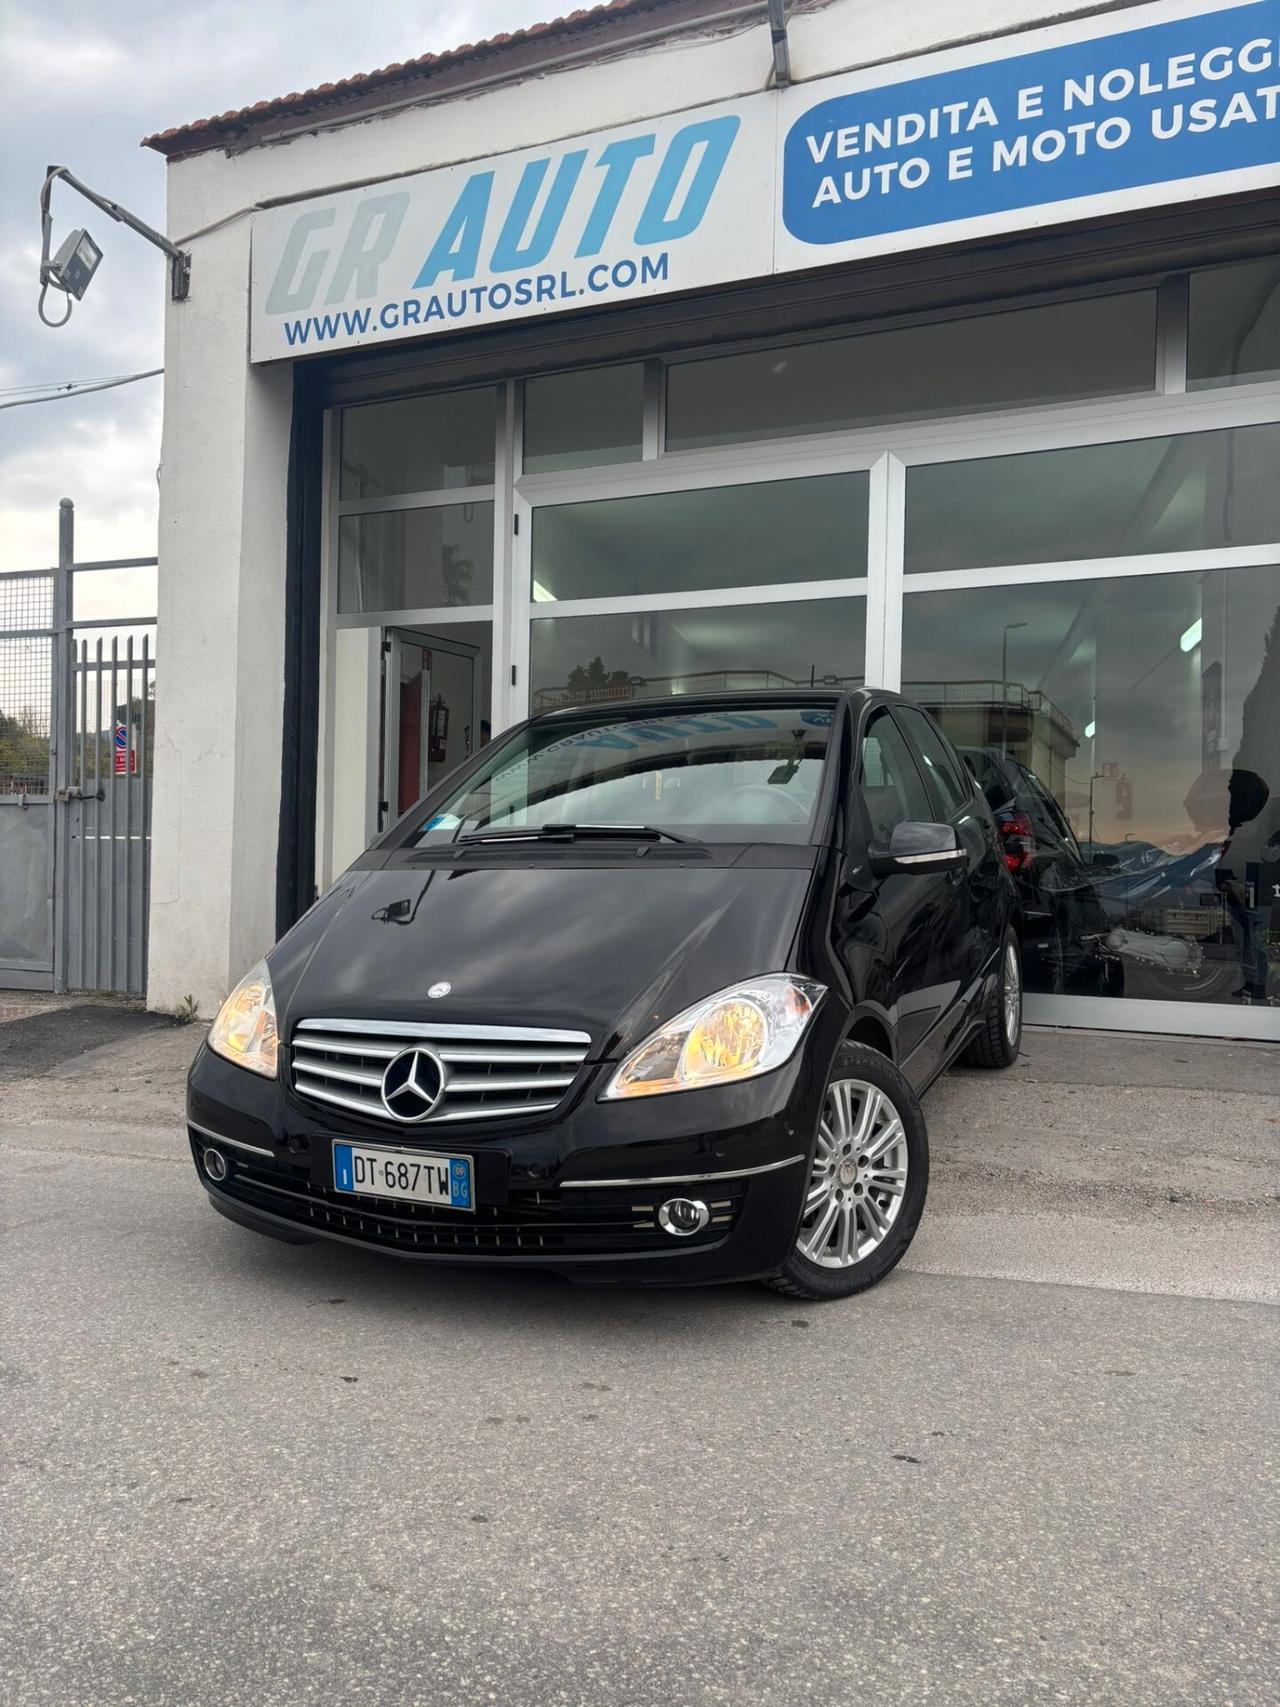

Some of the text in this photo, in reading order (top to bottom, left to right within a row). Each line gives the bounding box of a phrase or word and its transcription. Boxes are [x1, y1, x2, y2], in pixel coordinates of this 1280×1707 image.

[806, 35, 1280, 165] VENDITA E NOLEGG
[812, 84, 1280, 209] AUTO E MOTO USAT
[265, 114, 741, 316] GR AUTO
[284, 252, 669, 346] WWW.GRAUTOSRL.COM
[452, 1182, 468, 1199] BG
